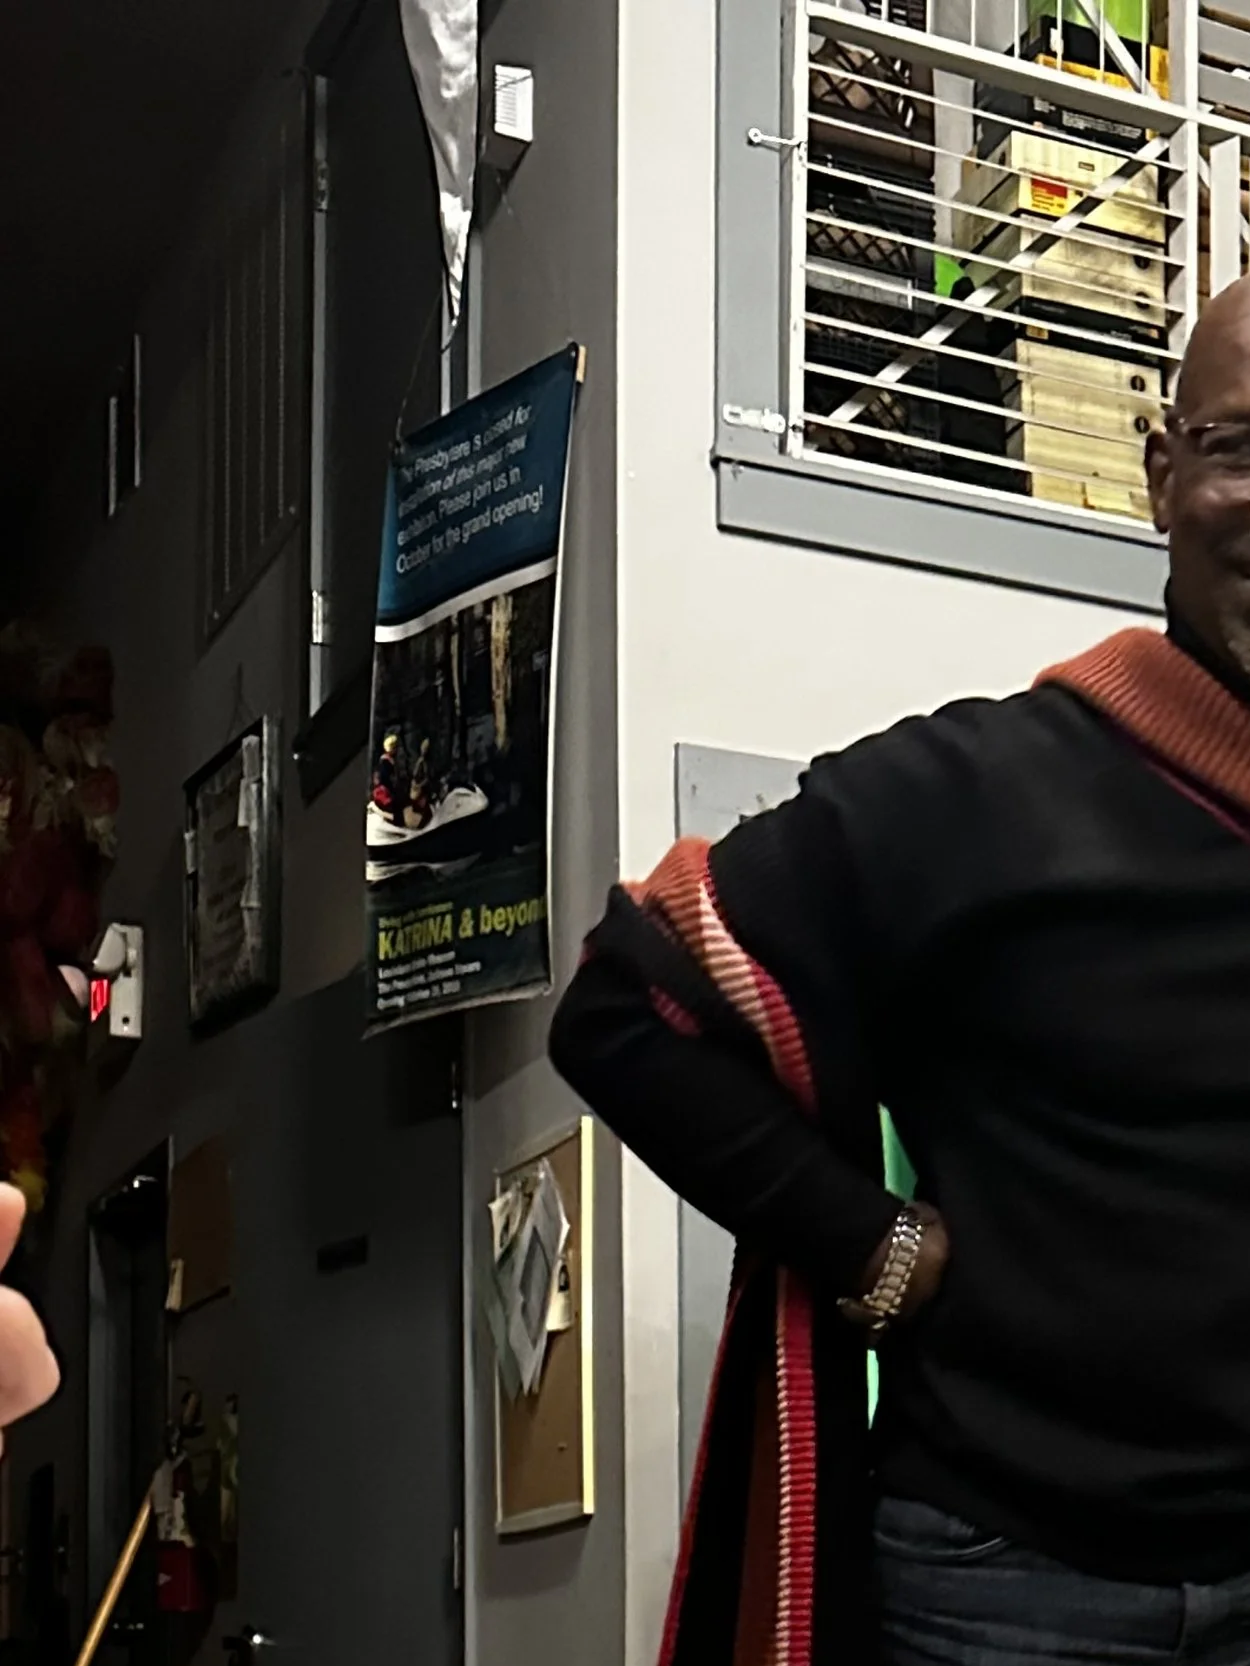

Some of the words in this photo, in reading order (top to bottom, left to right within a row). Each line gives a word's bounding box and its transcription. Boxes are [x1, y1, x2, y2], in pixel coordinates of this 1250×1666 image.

[514, 405, 532, 426] for
[439, 489, 471, 519] Please
[492, 473, 507, 492] us
[509, 465, 521, 486] in
[462, 506, 491, 544] grand
[492, 484, 543, 525] opening!
[378, 913, 454, 961] KATRINA
[458, 908, 475, 940] &
